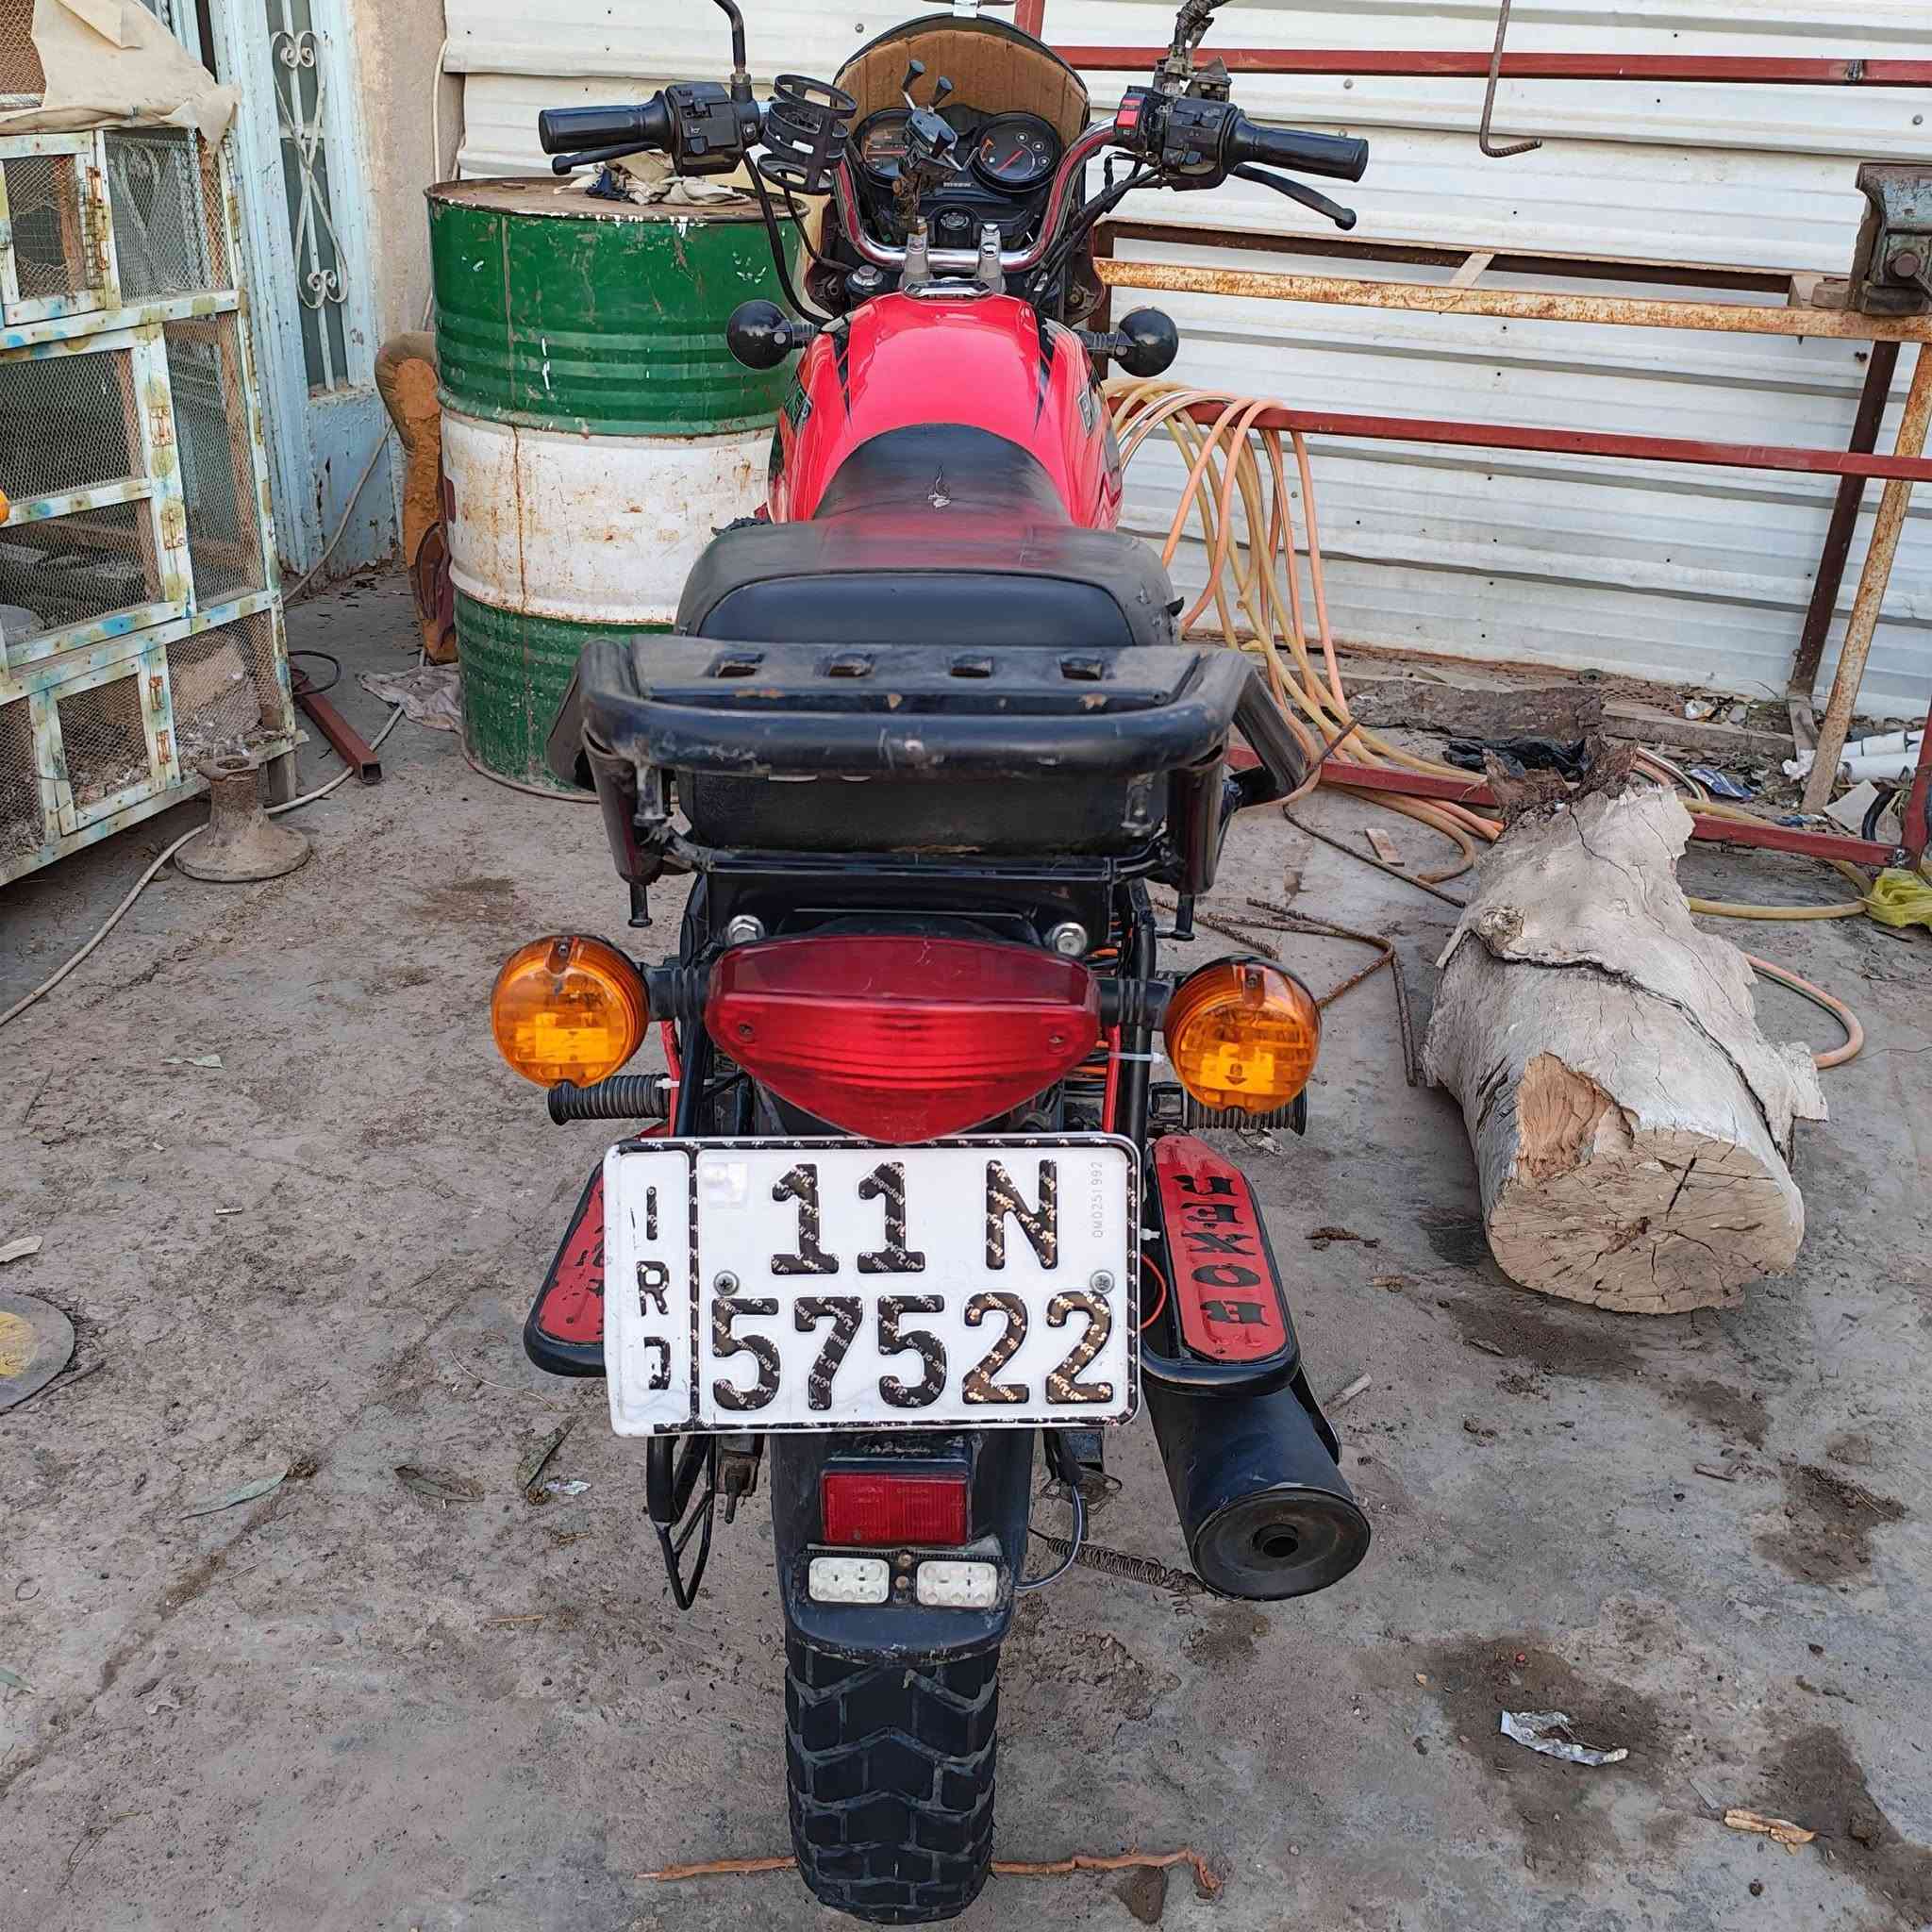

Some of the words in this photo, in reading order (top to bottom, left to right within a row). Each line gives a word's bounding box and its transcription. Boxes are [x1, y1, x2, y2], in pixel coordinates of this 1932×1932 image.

[771, 1161, 924, 1274] 11
[986, 1159, 1058, 1270] N
[712, 1291, 1114, 1410] 57522
